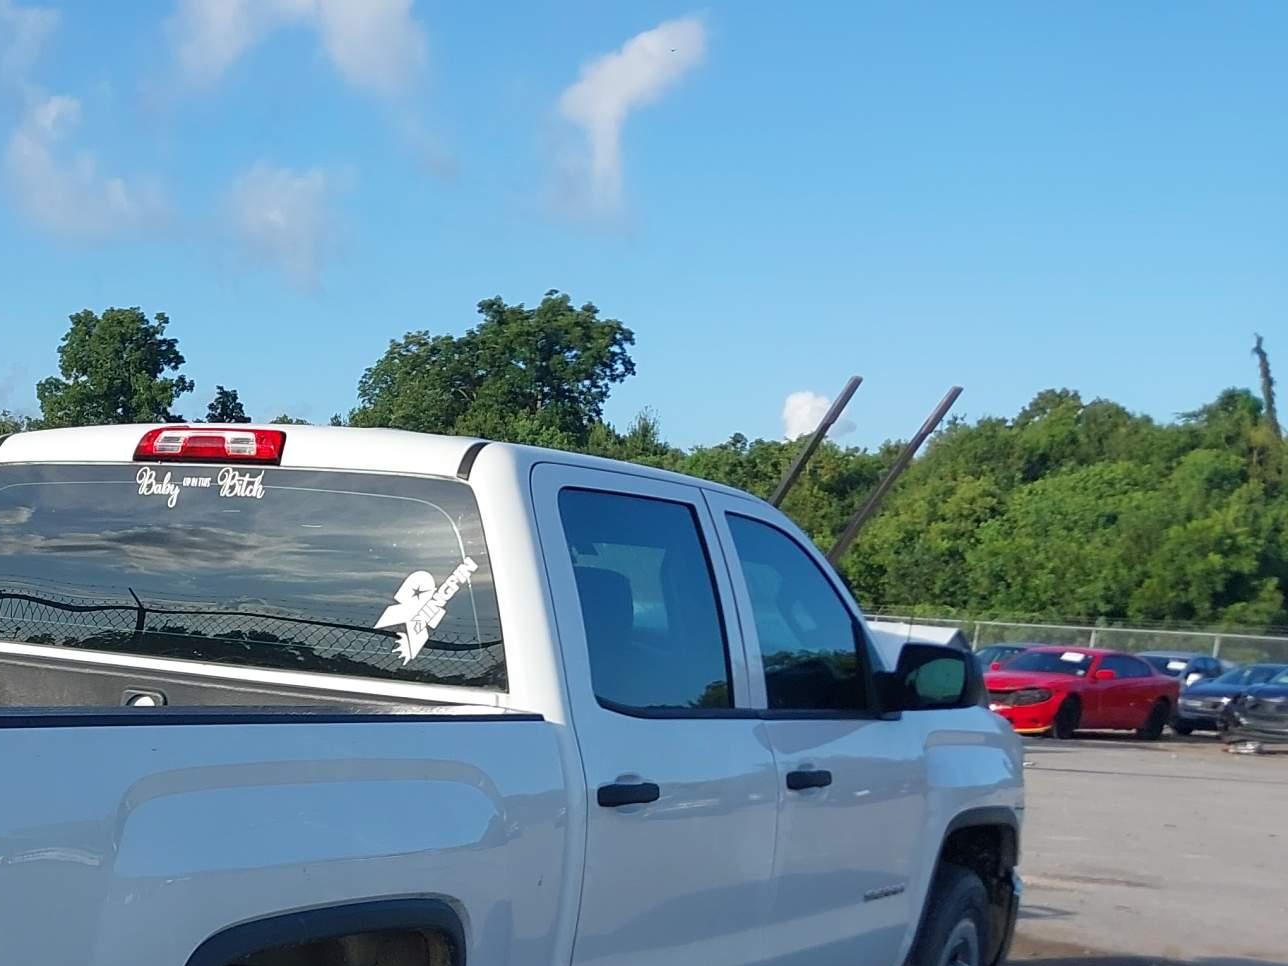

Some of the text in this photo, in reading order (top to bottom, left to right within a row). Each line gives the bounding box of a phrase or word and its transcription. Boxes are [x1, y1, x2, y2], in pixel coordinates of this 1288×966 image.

[136, 466, 181, 508] Baby
[217, 467, 265, 499] Bitch
[411, 557, 479, 634] KINGPIN
